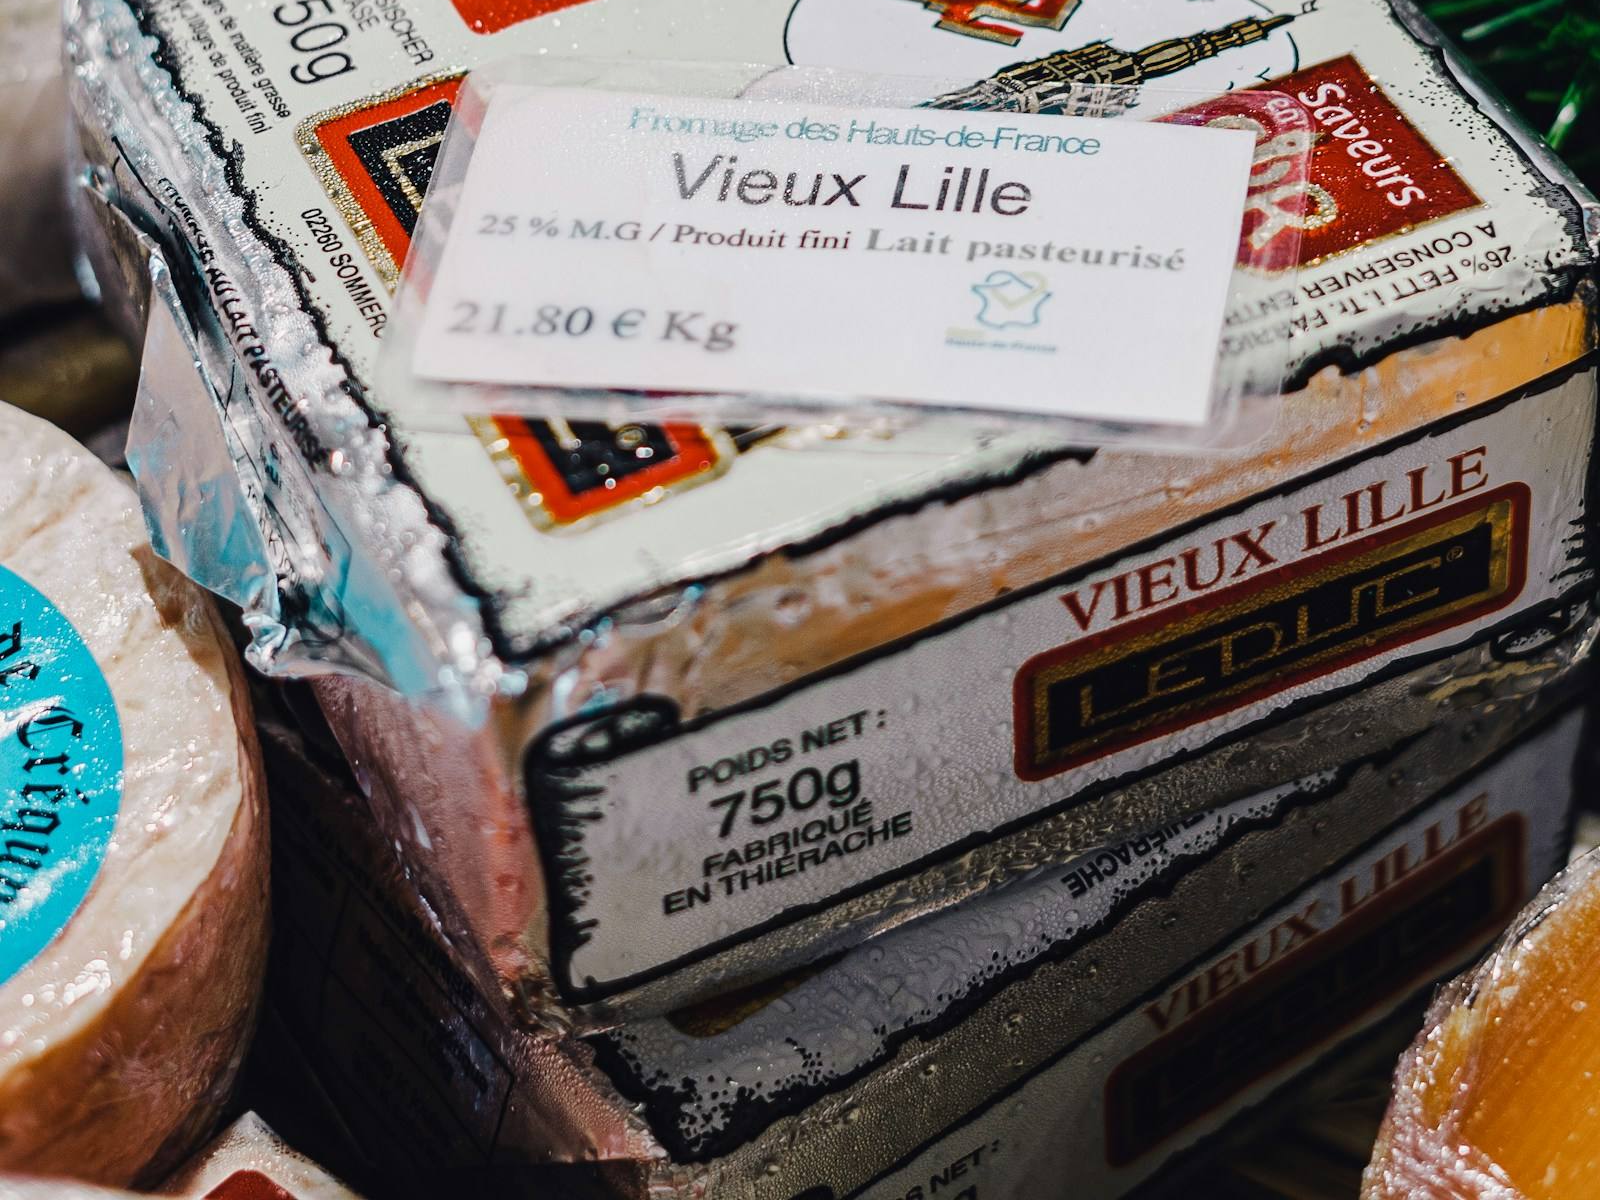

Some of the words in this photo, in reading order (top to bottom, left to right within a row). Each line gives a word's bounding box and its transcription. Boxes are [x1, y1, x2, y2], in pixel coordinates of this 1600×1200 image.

[212, 67, 257, 114] produit
[245, 111, 275, 137] fini
[229, 31, 267, 77] matière
[252, 76, 292, 121] grasse
[630, 106, 779, 143] Fromage
[785, 117, 839, 142] des
[848, 119, 1101, 155] Hauts-de-France
[1298, 83, 1426, 207] Saveurs
[673, 151, 867, 206] Vieux
[890, 163, 1033, 216] Lille
[301, 208, 343, 253] 02260
[477, 213, 519, 237] 25
[529, 216, 560, 238] %
[570, 220, 643, 242] M.G
[649, 222, 666, 242] /
[673, 224, 788, 249] Produit
[798, 228, 851, 250] fini
[865, 228, 953, 255] Lait
[965, 239, 1186, 272] pasteurisé
[1475, 220, 1497, 239] A
[207, 264, 238, 296] AU
[1302, 230, 1475, 298] CONSERVER
[1391, 264, 1461, 302] FETT
[1462, 245, 1513, 274] 26%
[220, 298, 259, 342] LAIT
[448, 300, 594, 338] 21.80
[611, 307, 647, 338] €
[660, 309, 741, 351] Kg
[1056, 520, 1280, 632] VIEUX
[1300, 444, 1490, 553] LILLE
[686, 737, 795, 794] POIDS
[800, 709, 869, 754] NET
[708, 756, 863, 839] 750g
[702, 795, 874, 879] FABRIQUÉ
[663, 881, 712, 916] EN
[1143, 897, 1321, 1034] VIEUX
[1337, 790, 1491, 918] LILLE
[928, 1144, 986, 1194] NET
